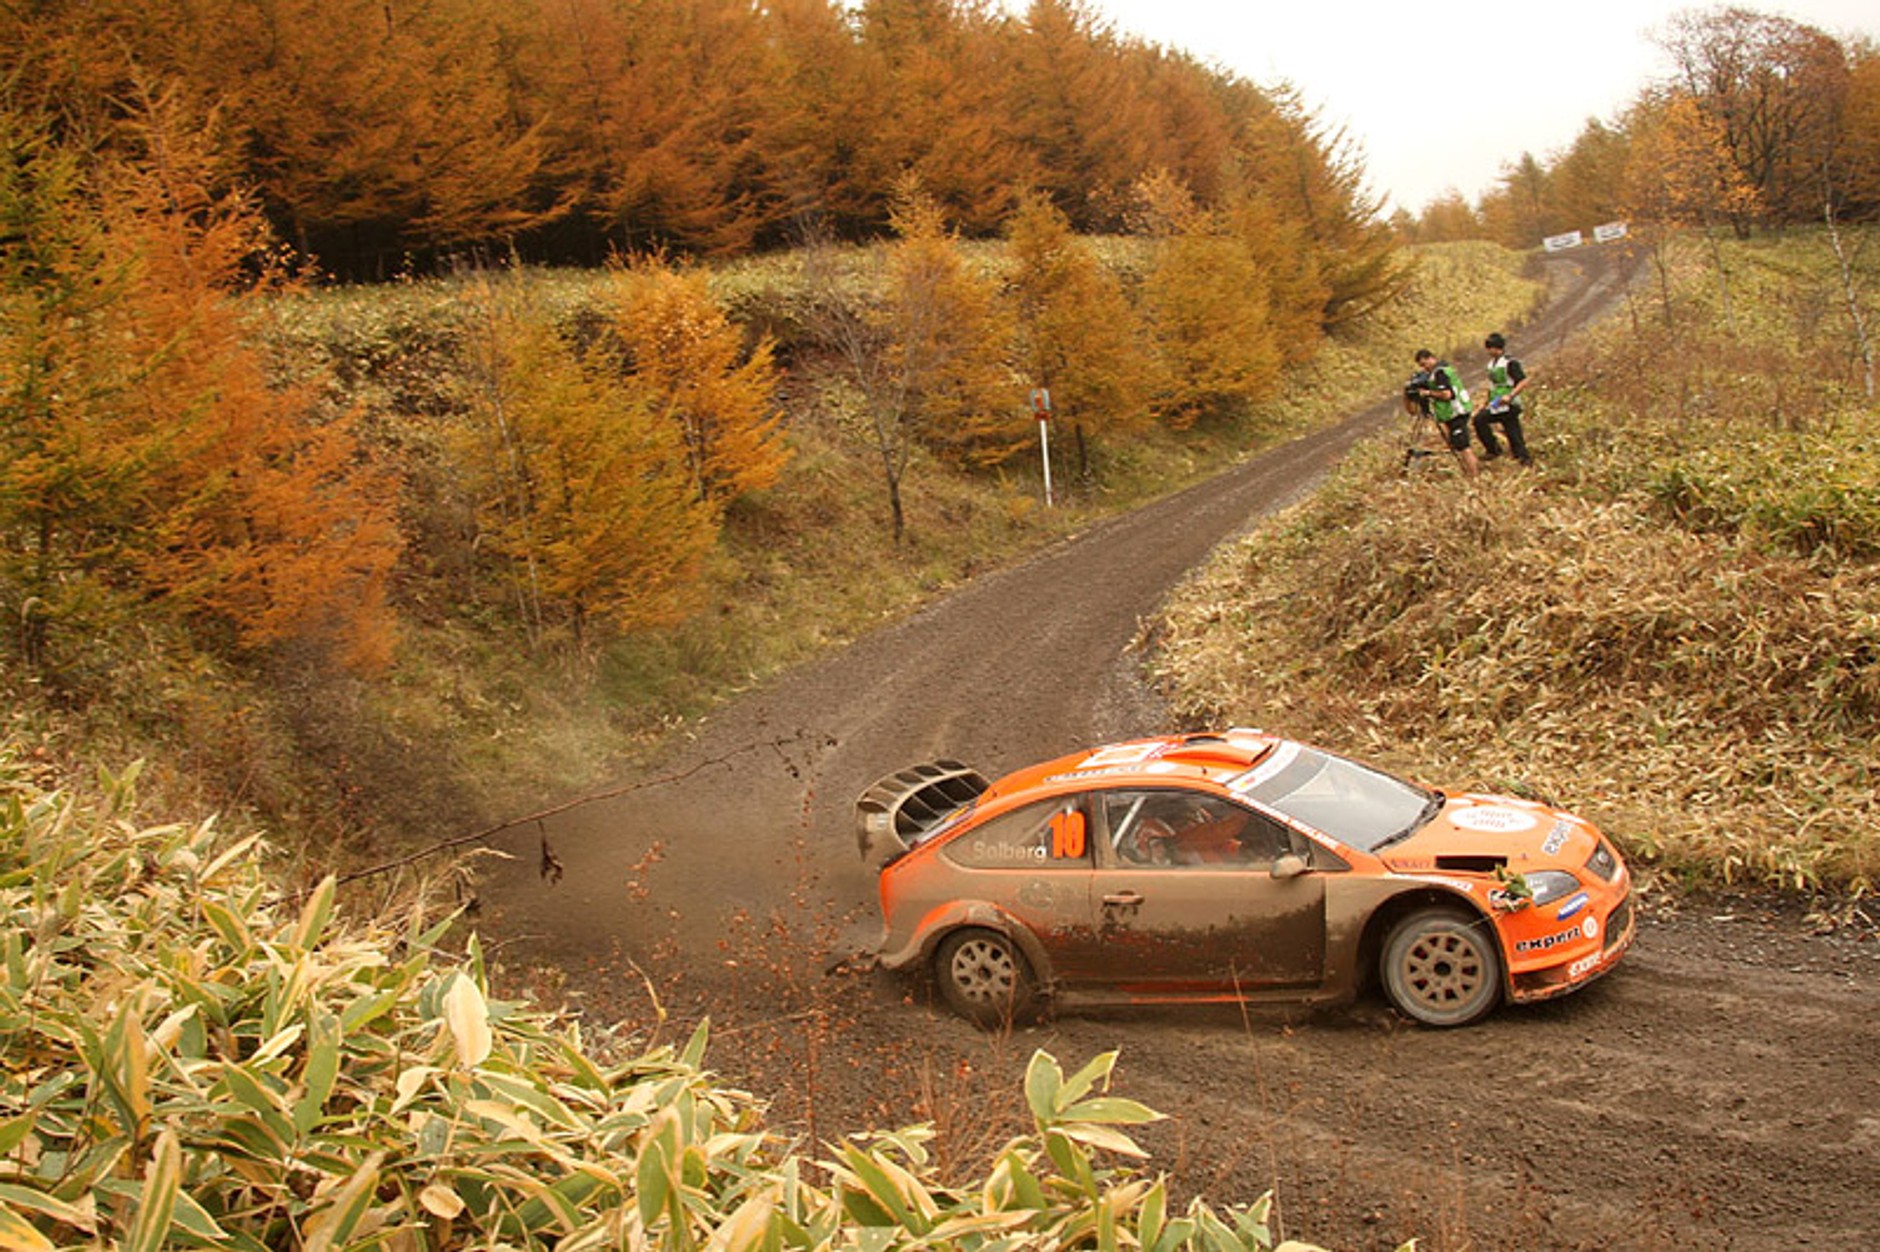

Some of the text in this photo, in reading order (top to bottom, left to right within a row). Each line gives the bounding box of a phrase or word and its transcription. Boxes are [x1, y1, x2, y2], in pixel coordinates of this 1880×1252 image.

[1048, 811, 1086, 859] 10
[973, 841, 1047, 864] Solberg
[1516, 926, 1581, 952] expert
